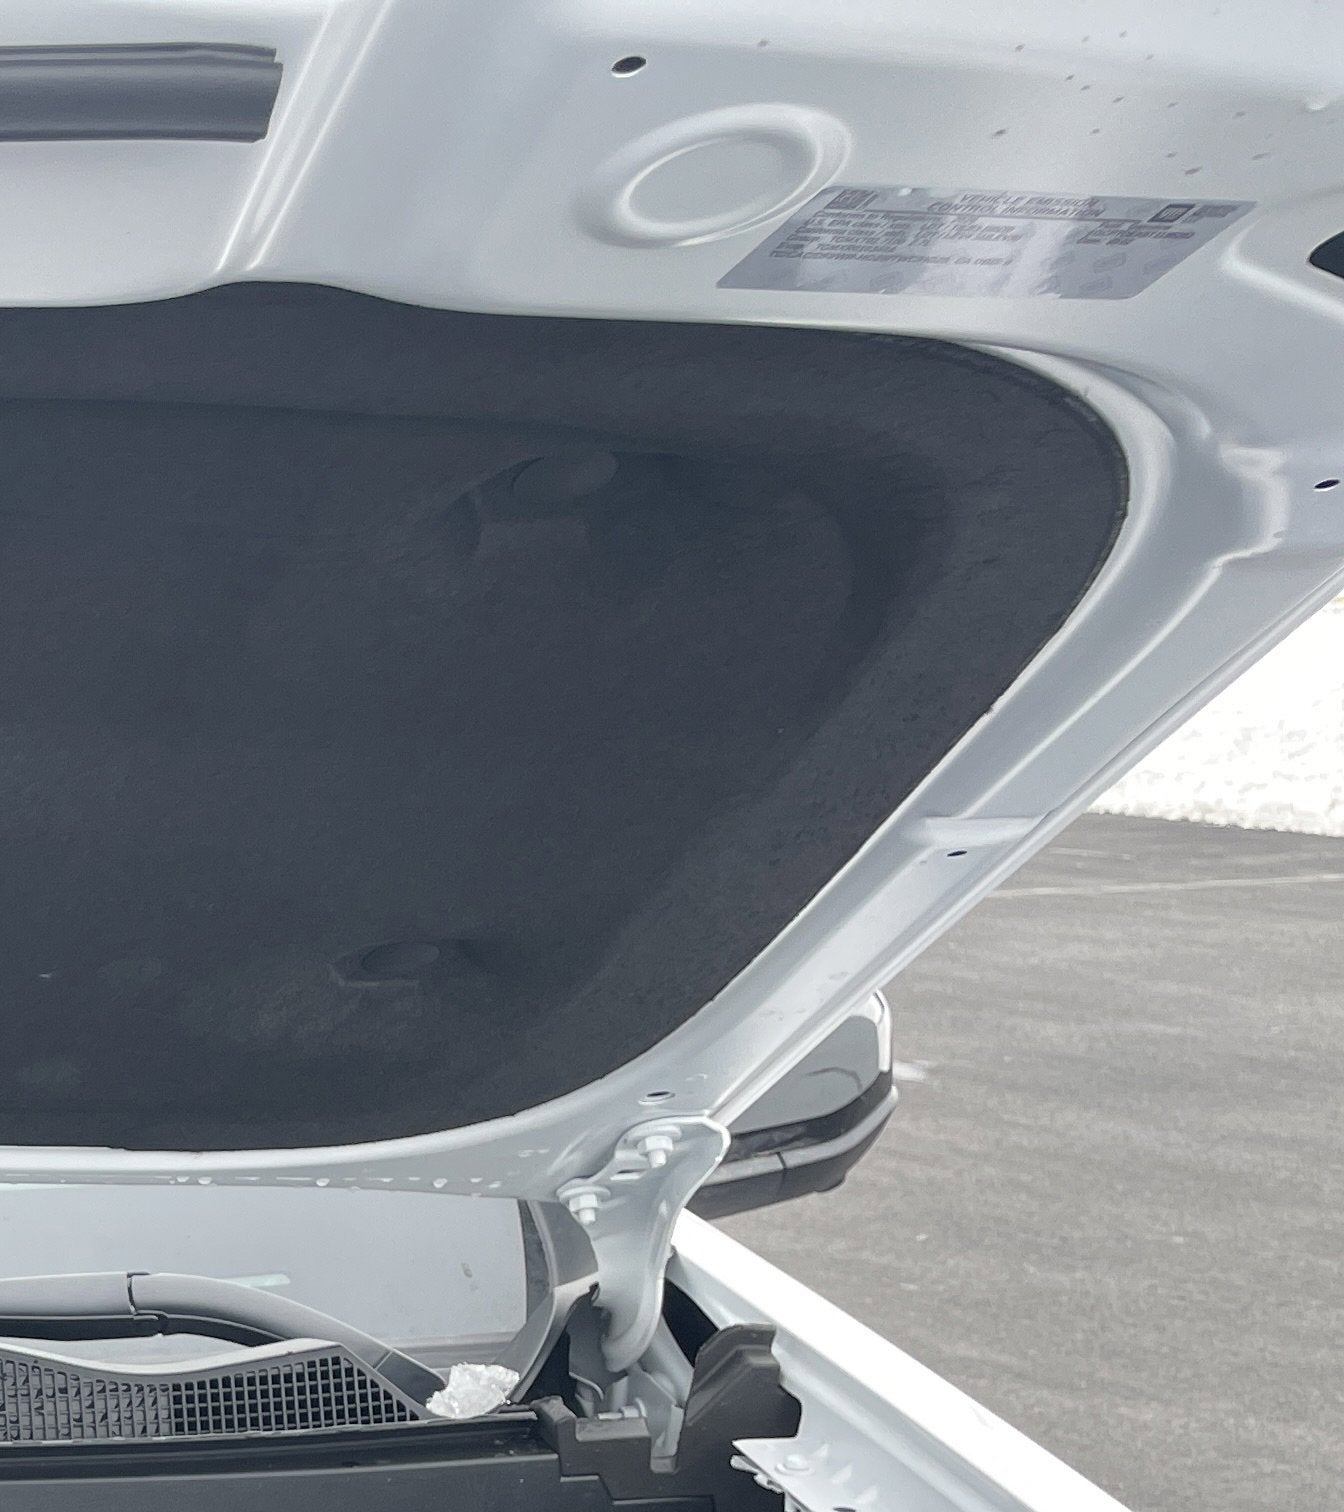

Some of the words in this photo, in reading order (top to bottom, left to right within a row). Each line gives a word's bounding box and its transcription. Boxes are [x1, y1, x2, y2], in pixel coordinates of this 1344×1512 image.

[959, 193, 1025, 204] VEHICLE
[1024, 195, 1102, 207] EMISSION
[927, 201, 999, 212] CONTROL
[1001, 203, 1107, 216] INFORMATION
